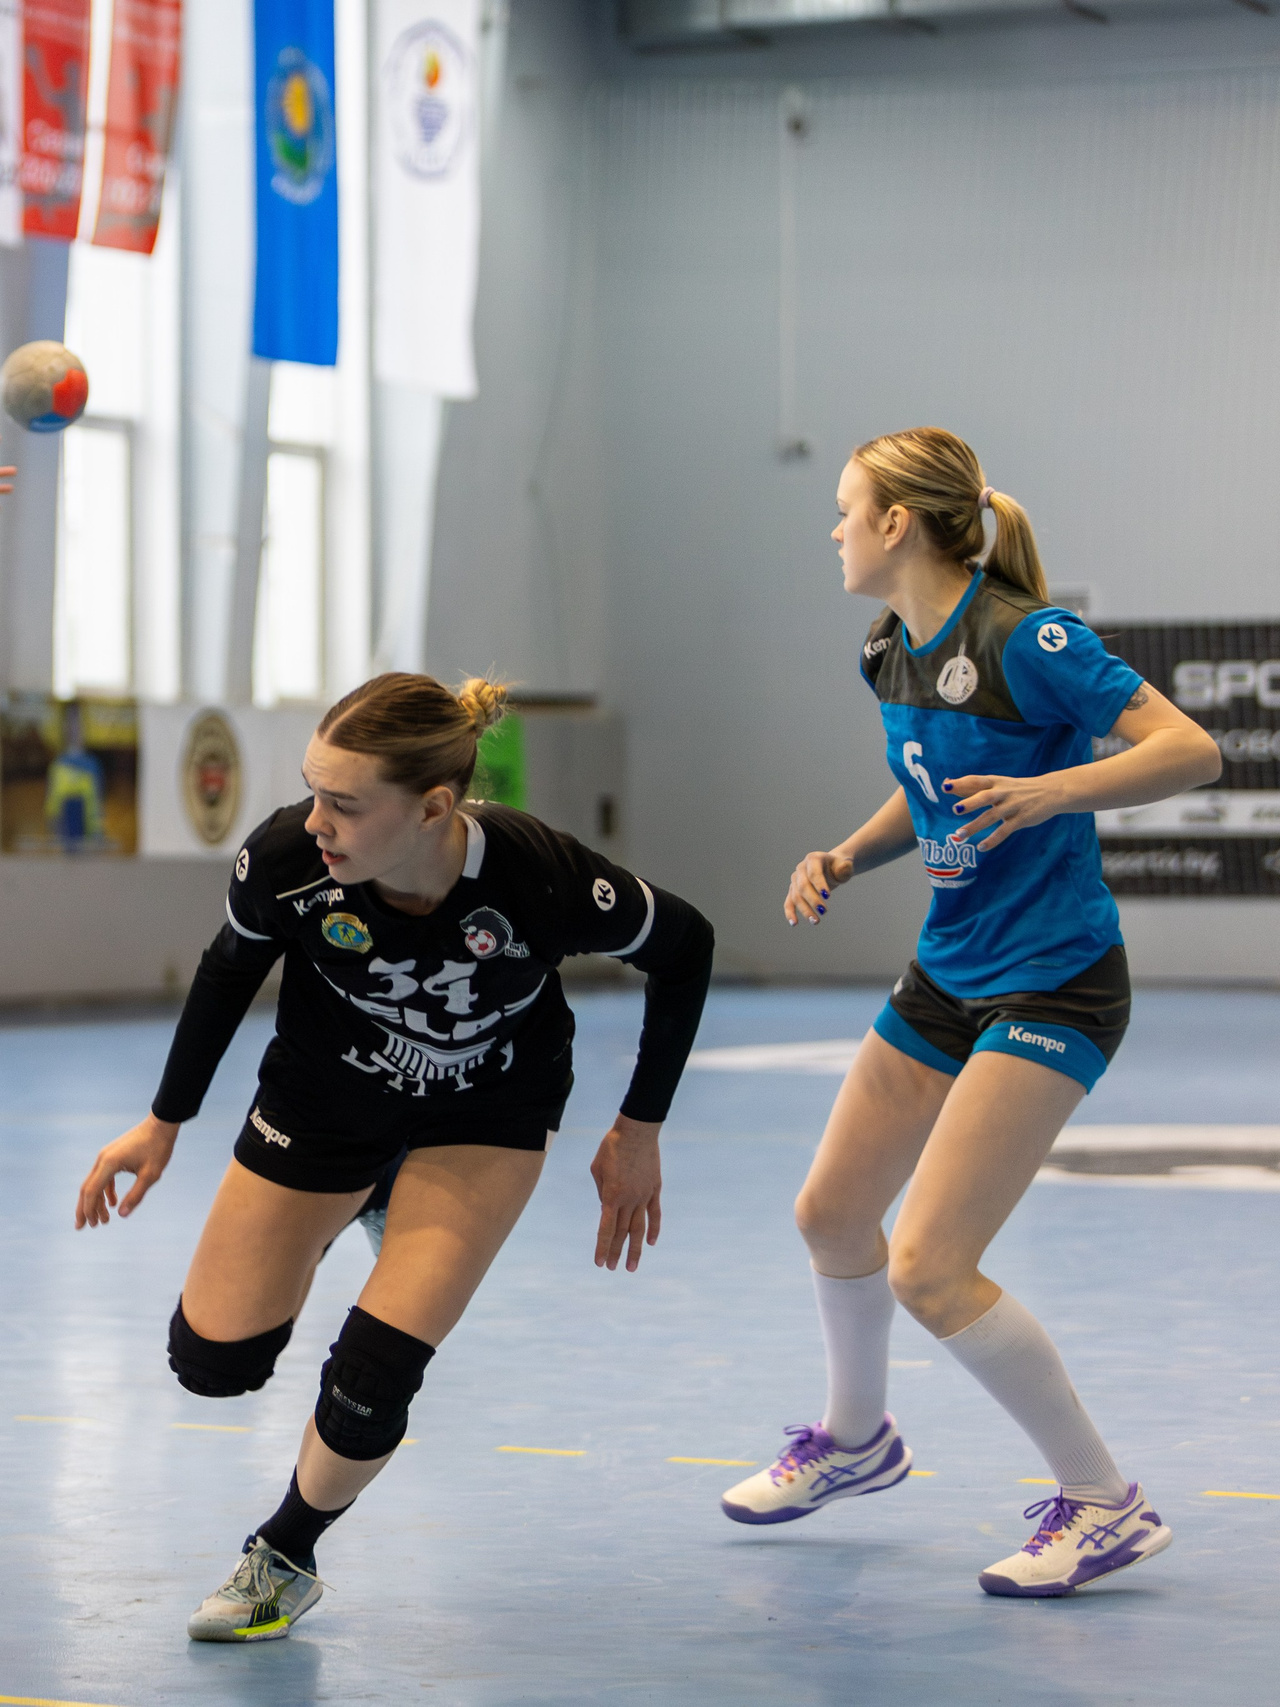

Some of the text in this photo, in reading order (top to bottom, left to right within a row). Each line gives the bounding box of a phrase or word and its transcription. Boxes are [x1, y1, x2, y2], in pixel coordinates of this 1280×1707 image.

[903, 741, 939, 803] 6
[367, 956, 479, 1016] 34
[1007, 1025, 1066, 1054] Kempa
[249, 1105, 292, 1149] Kempa
